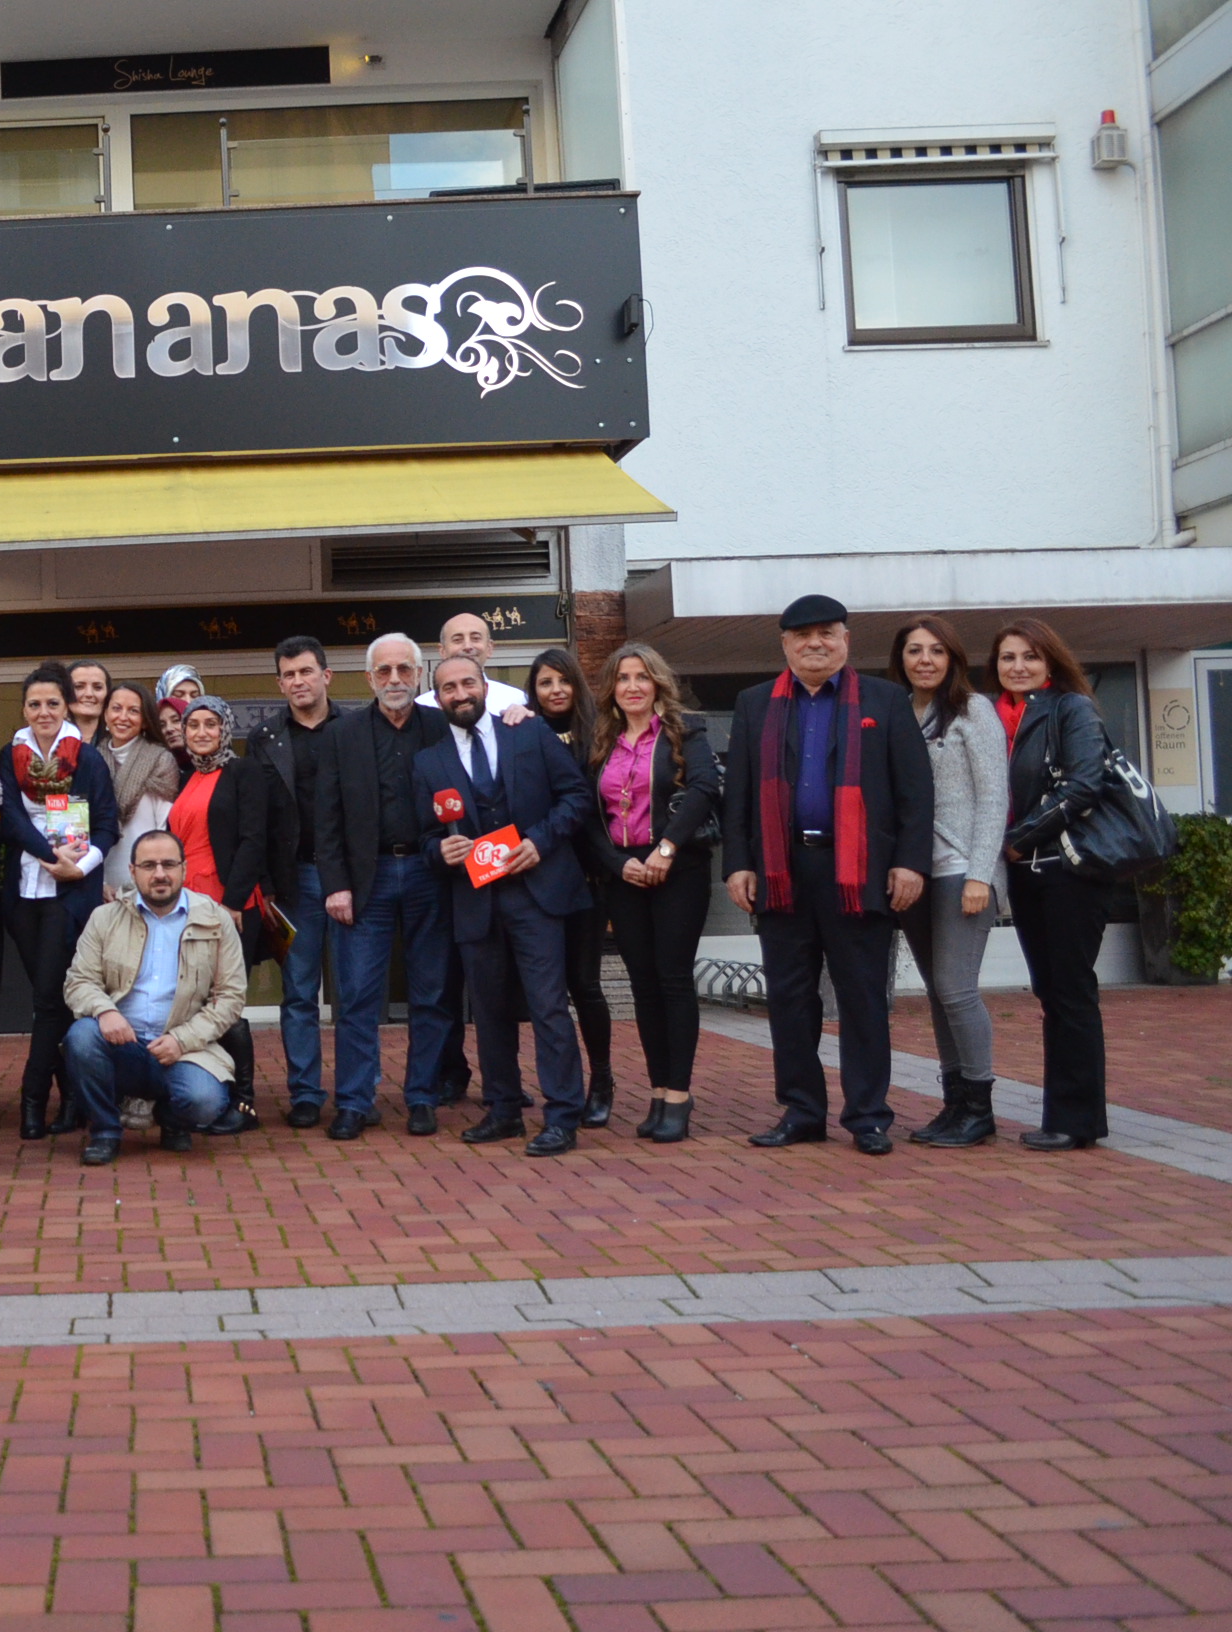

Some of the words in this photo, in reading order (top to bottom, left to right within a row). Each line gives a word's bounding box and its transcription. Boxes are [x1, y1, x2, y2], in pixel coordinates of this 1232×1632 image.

[113, 59, 165, 90] Shisha
[169, 55, 215, 86] Lounge
[1155, 740, 1187, 750] Raum
